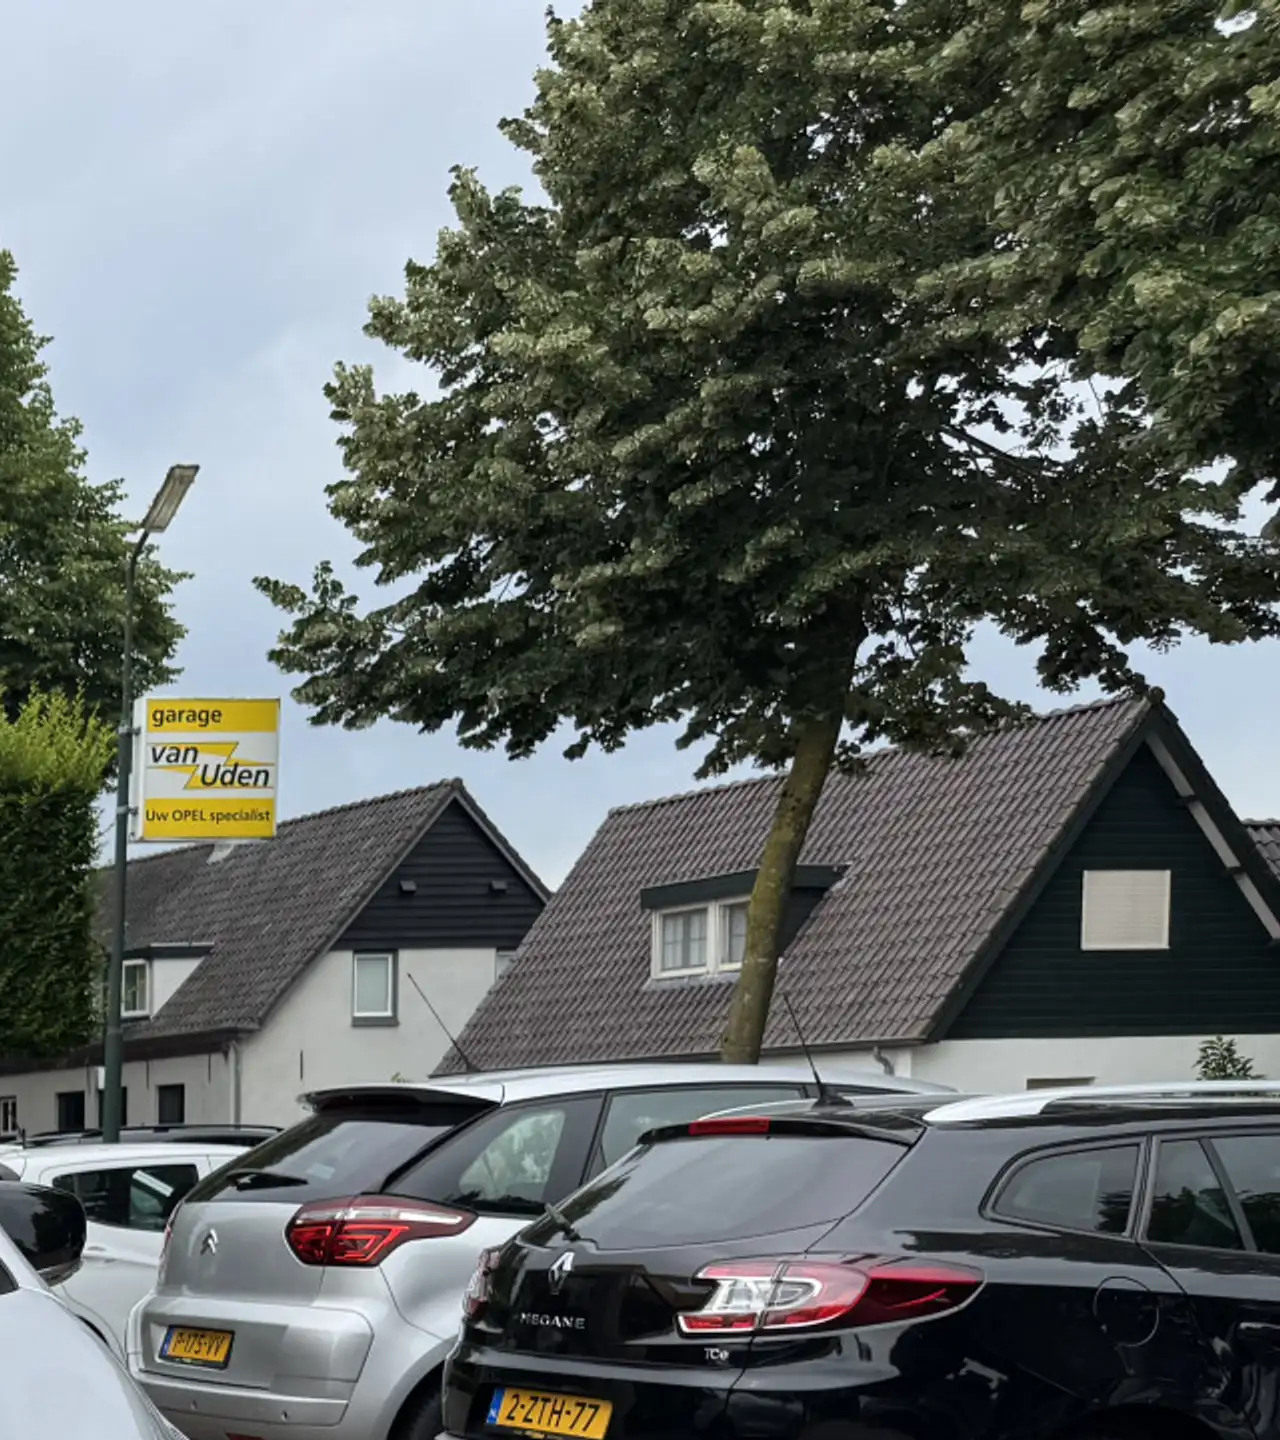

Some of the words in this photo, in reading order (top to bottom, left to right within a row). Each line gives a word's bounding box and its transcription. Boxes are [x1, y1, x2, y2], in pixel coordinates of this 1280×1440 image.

[151, 708, 222, 727] garage
[151, 745, 199, 763] van
[200, 762, 270, 787] Uden
[146, 810, 168, 821] Uw
[172, 810, 206, 821] OPEL
[210, 809, 270, 825] specialist
[520, 1312, 586, 1330] MEGANE
[505, 1393, 601, 1433] 2-ZTH-77
